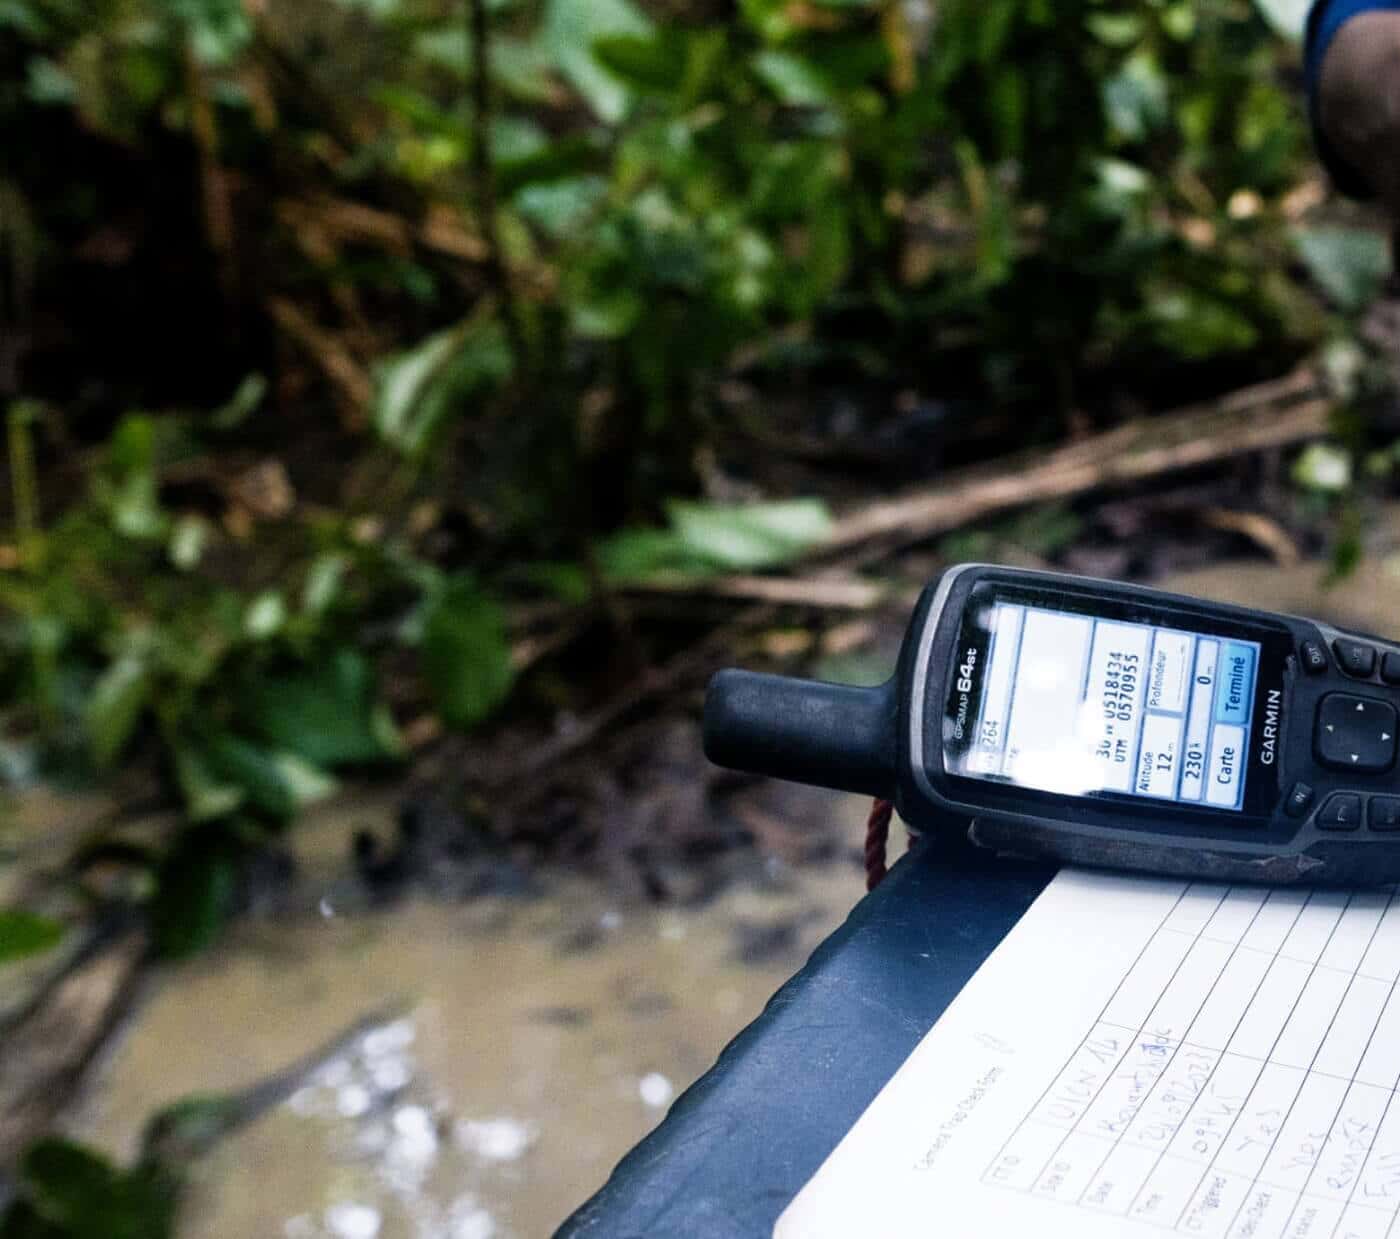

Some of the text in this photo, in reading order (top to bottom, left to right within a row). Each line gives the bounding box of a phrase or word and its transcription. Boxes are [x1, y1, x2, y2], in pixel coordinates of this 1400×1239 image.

[954, 648, 978, 740] GPSMAP 64st
[1150, 650, 1167, 706] Profondeur
[1197, 675, 1212, 686] 0
[1225, 656, 1246, 712] Terminé
[1114, 653, 1140, 763] UTM 0570955
[1260, 689, 1281, 765] GARMIN
[982, 720, 1000, 746] 264
[1156, 752, 1173, 772] 12
[1185, 748, 1203, 780] 230
[1217, 746, 1235, 785] Carte
